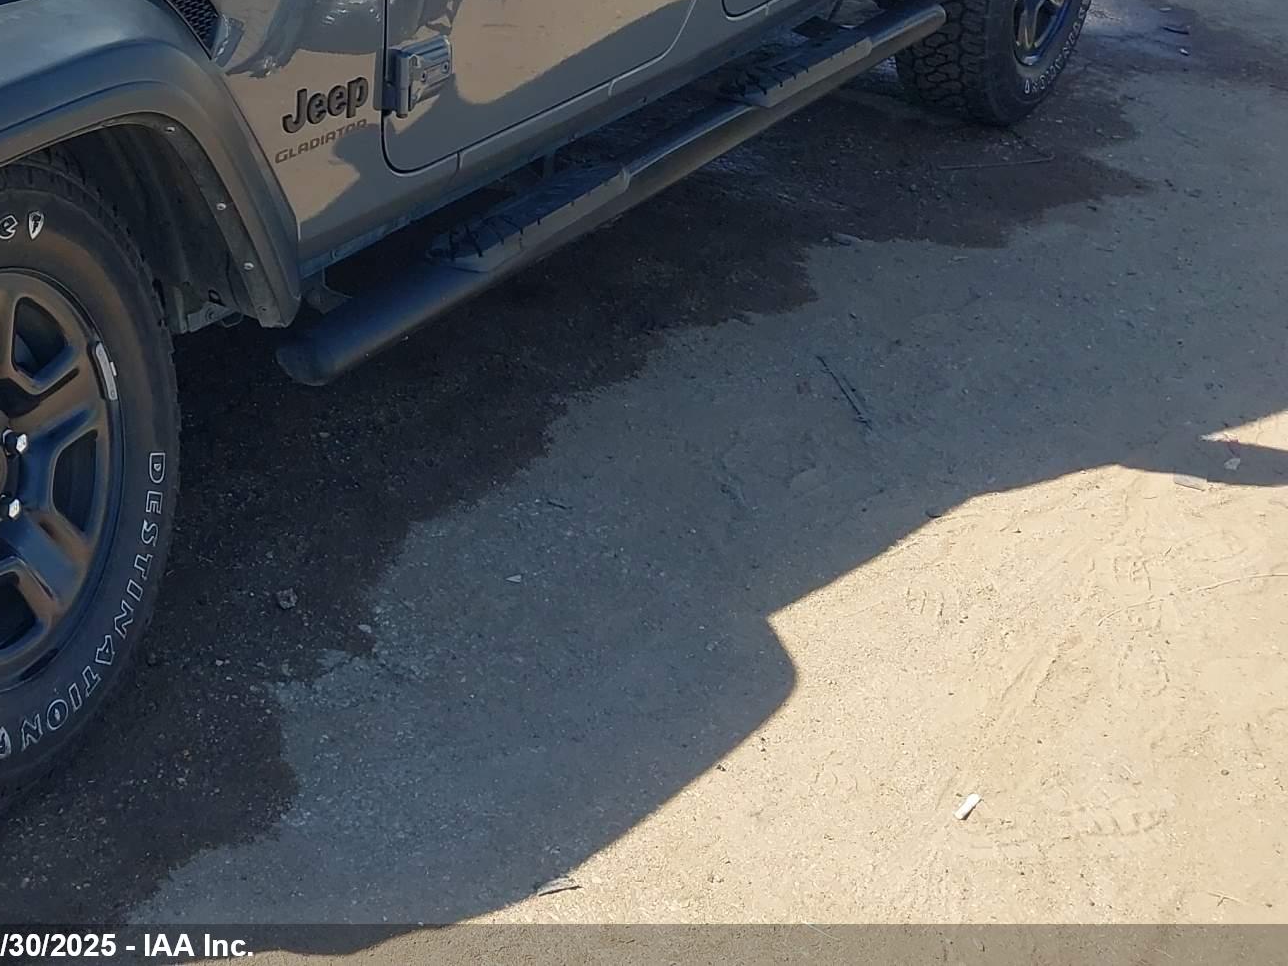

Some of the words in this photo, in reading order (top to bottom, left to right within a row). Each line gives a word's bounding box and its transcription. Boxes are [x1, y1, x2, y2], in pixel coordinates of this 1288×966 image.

[282, 77, 369, 134] Jeep
[274, 118, 368, 164] GLADIATOR
[20, 451, 166, 753] DESTINATION
